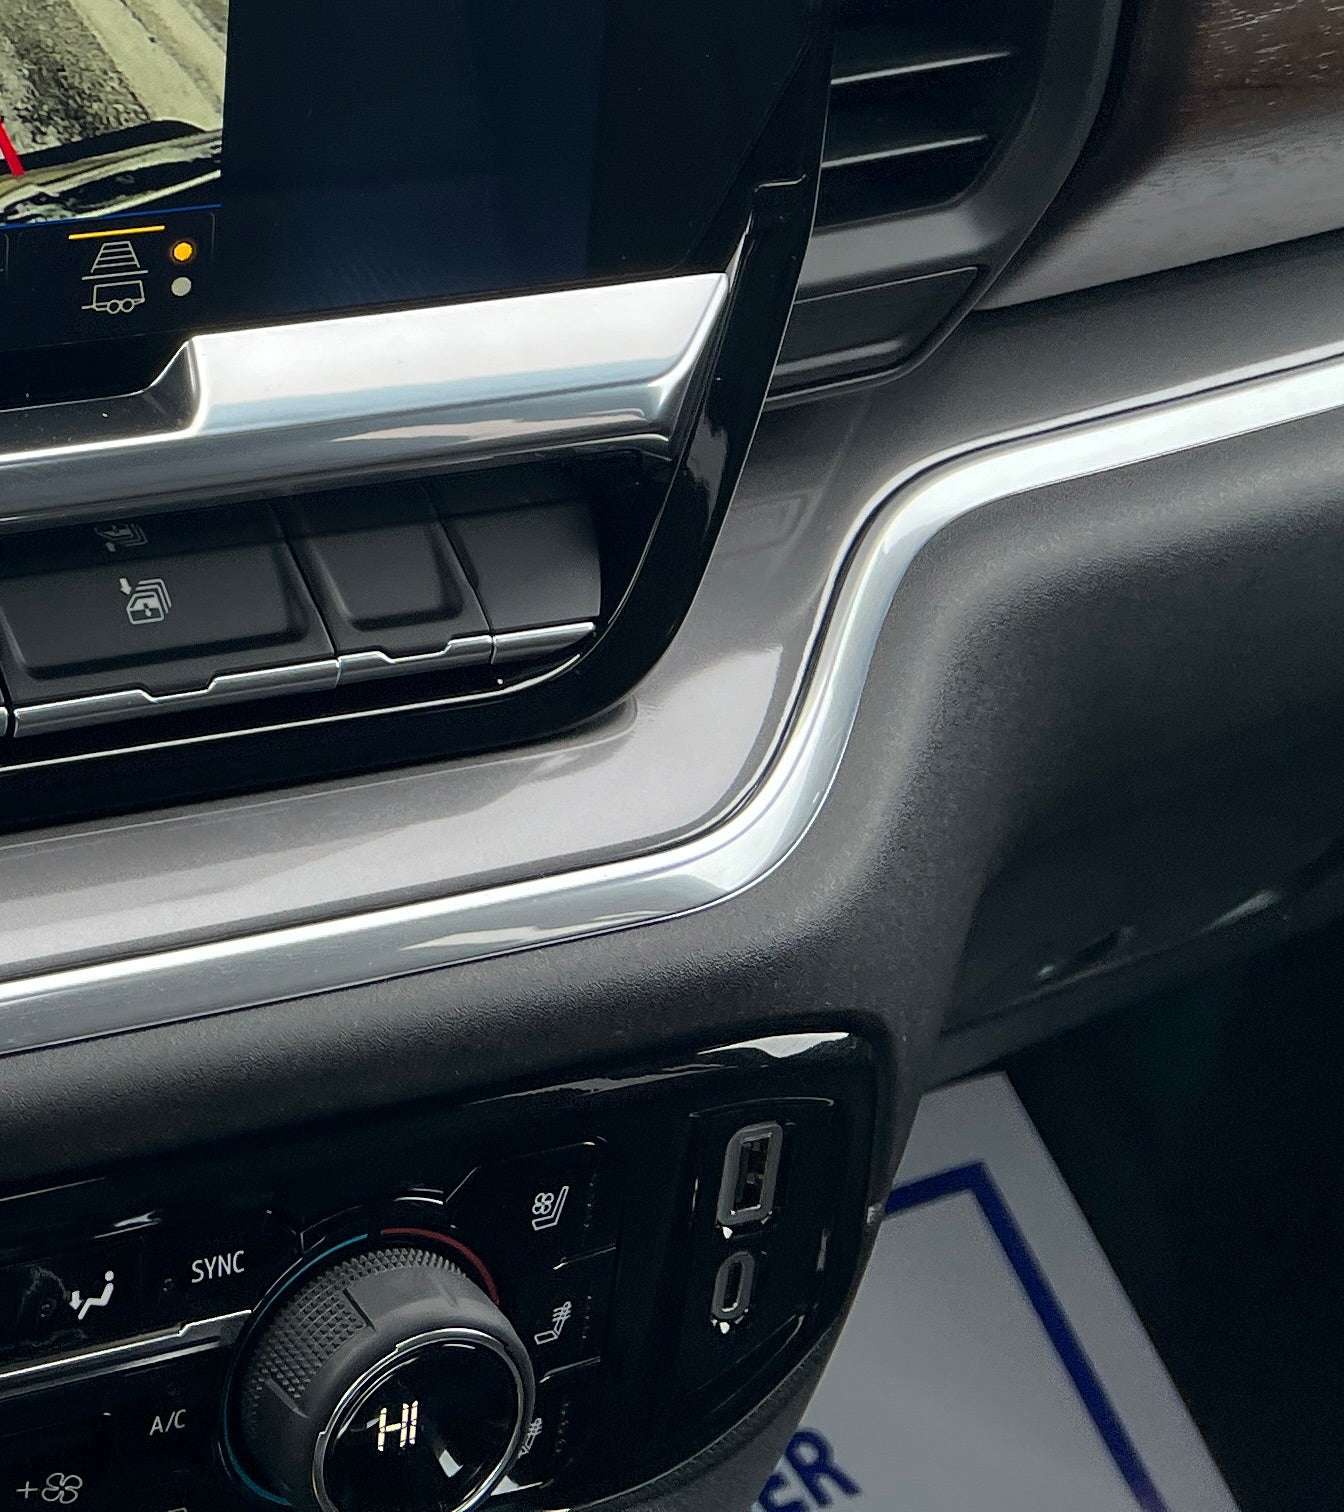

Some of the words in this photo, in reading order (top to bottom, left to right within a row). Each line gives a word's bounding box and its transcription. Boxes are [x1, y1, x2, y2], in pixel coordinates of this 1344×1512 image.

[191, 1250, 245, 1284] SYNC
[149, 1409, 187, 1435] A/C
[377, 1400, 419, 1452] HI
